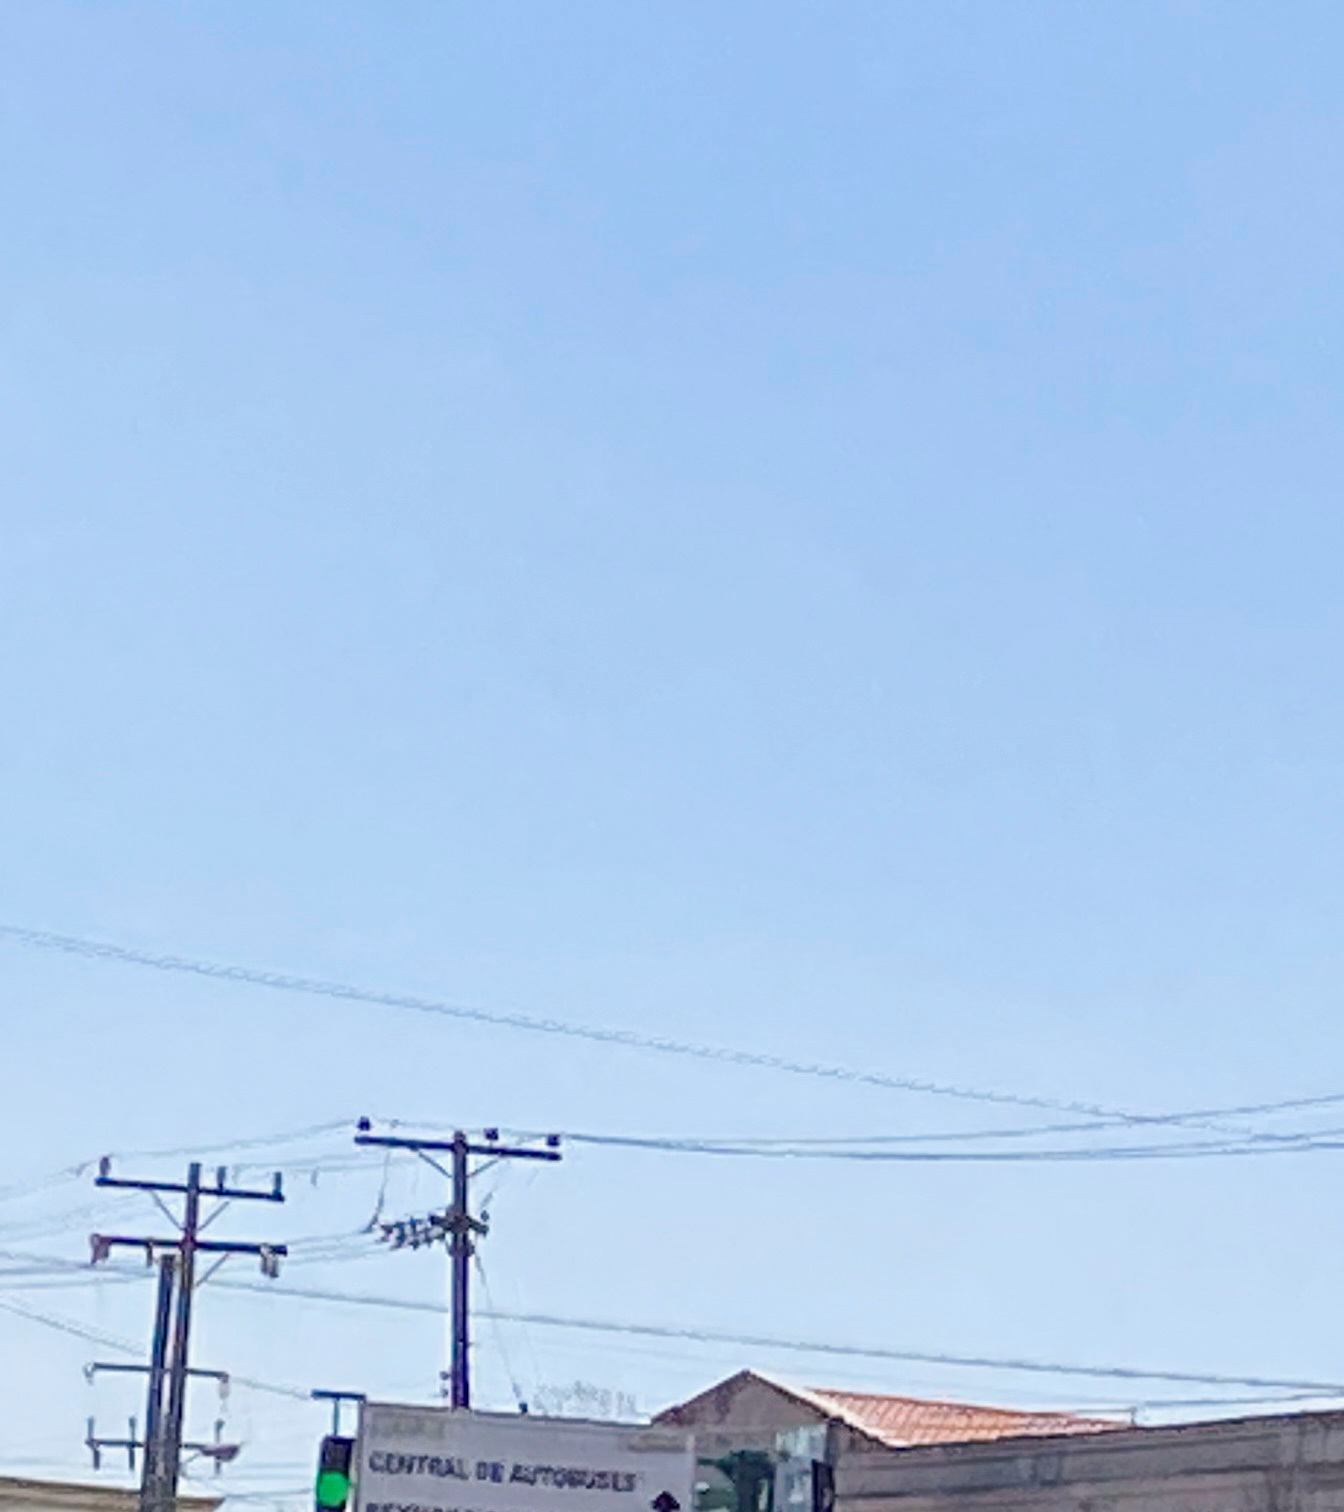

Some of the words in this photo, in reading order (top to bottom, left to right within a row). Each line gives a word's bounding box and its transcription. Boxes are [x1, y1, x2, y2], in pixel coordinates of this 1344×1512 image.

[368, 1451, 470, 1480] CENTRAL
[475, 1461, 503, 1483] DE
[509, 1464, 637, 1492] AUTOBUSES
